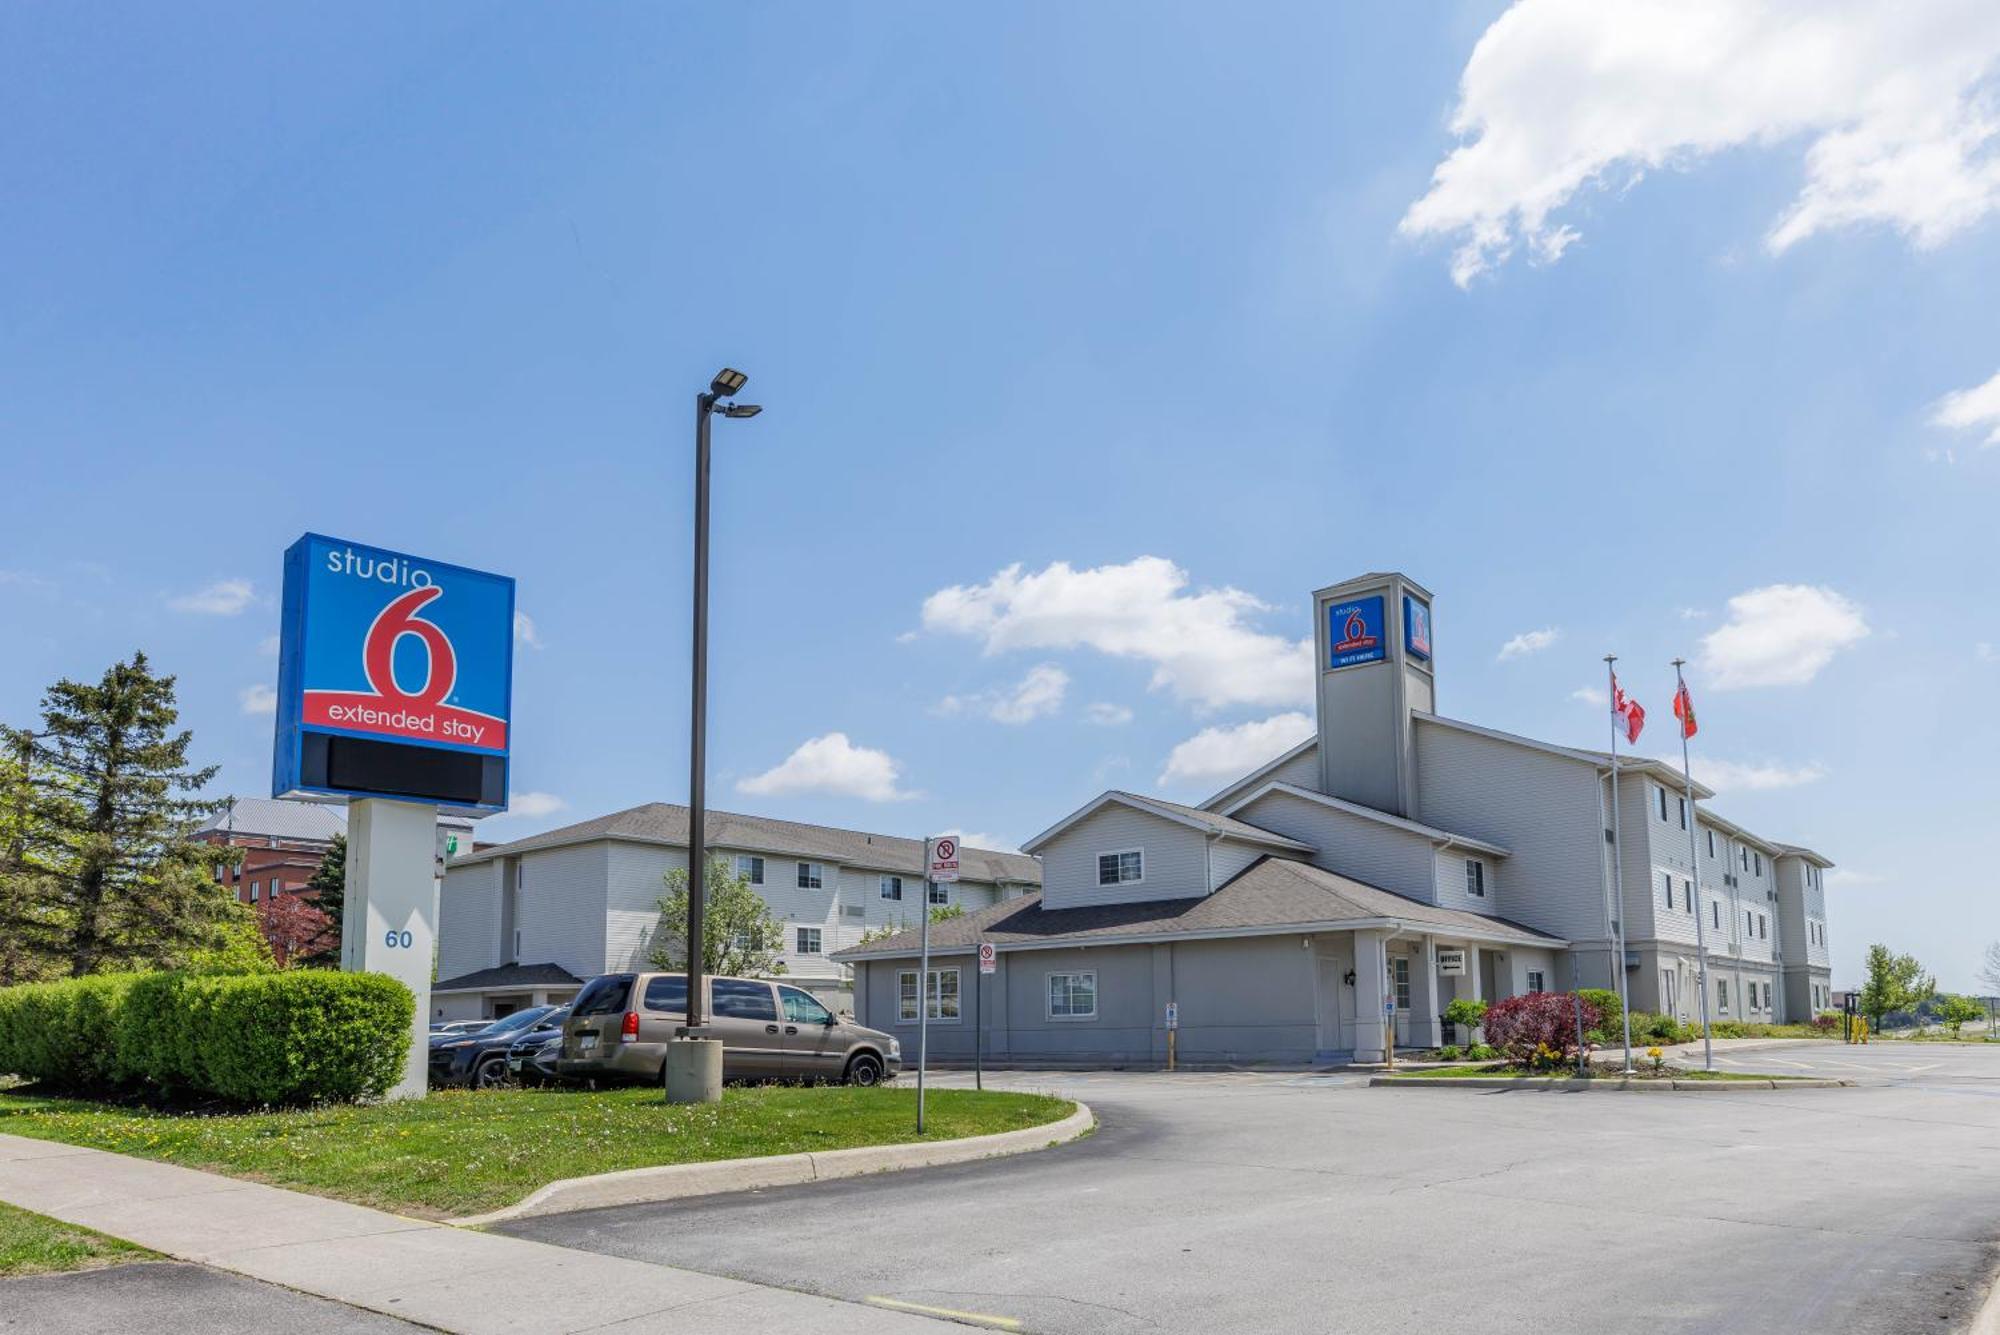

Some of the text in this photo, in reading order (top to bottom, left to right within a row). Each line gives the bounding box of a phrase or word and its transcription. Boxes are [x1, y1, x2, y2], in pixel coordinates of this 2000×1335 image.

[327, 548, 432, 589] studio
[1344, 607, 1366, 641] 6
[363, 586, 458, 705] 6
[328, 704, 485, 742] extended stay
[385, 930, 412, 948] 60
